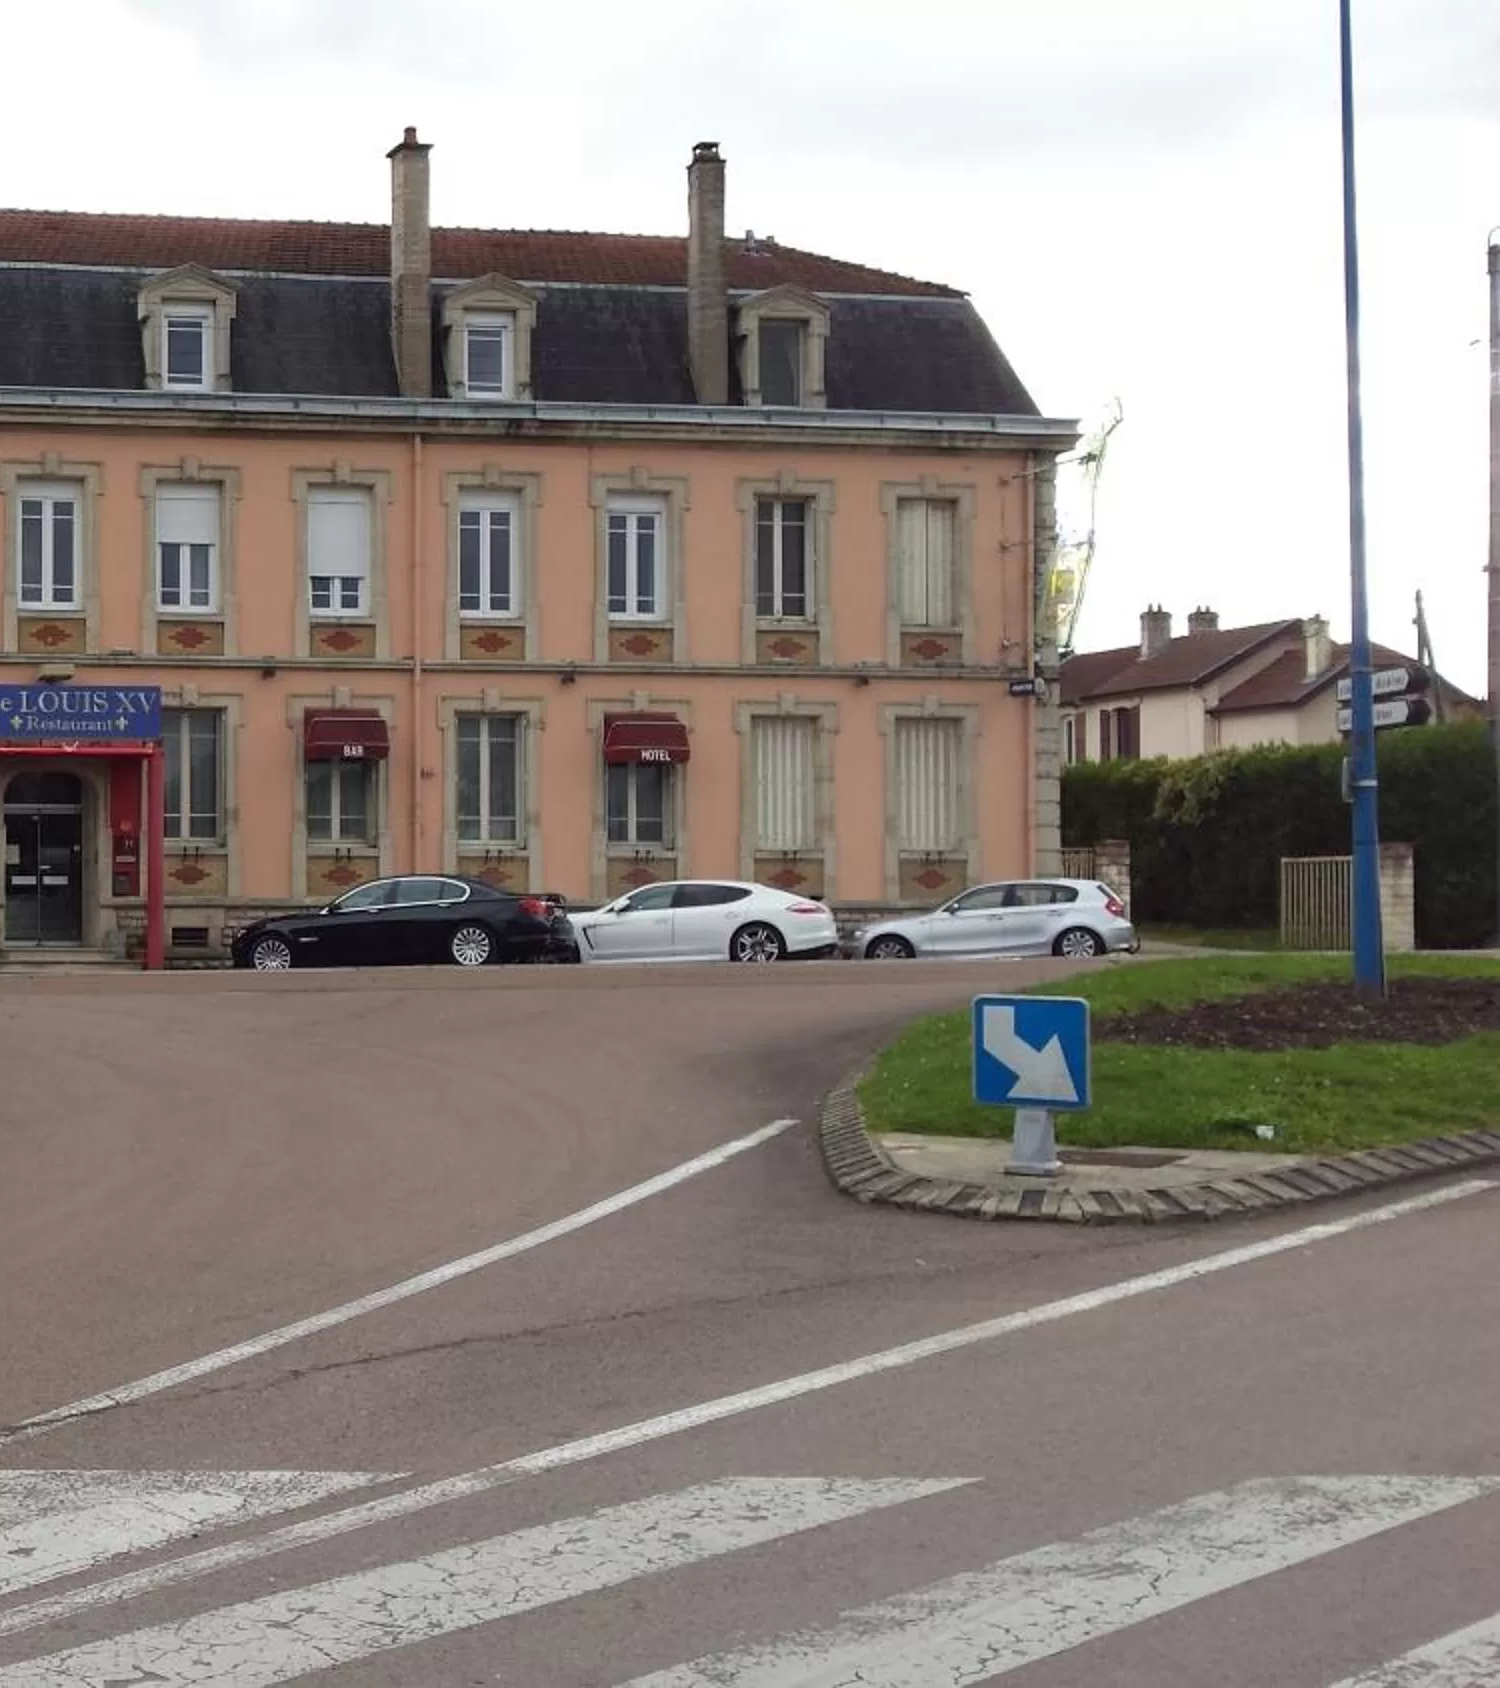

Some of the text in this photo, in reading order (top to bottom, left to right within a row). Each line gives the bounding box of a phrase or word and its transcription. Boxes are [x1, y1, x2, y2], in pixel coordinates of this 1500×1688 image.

[19, 691, 109, 713] LOUIS
[115, 691, 156, 715] XV
[26, 715, 111, 732] Restaurant
[343, 745, 364, 757] BAR
[641, 750, 671, 761] HOTEL
